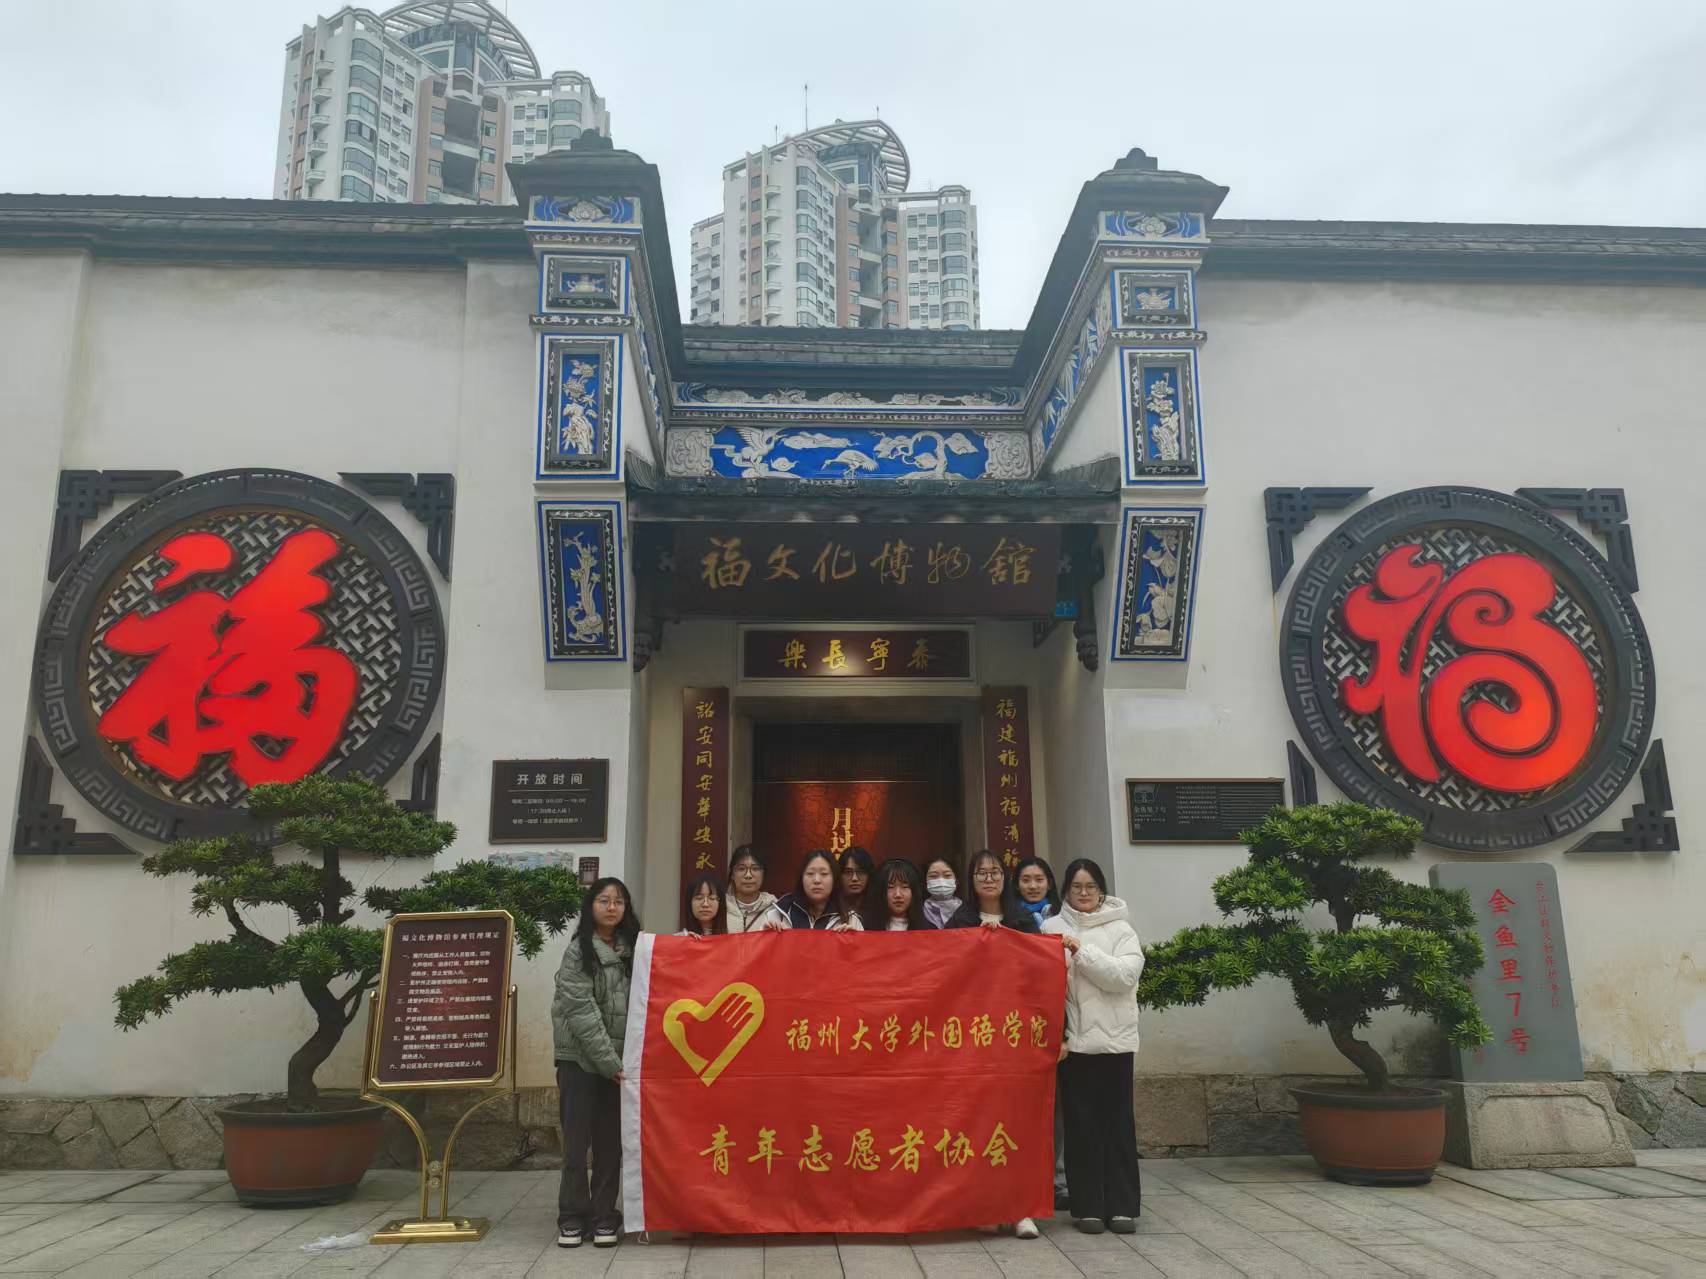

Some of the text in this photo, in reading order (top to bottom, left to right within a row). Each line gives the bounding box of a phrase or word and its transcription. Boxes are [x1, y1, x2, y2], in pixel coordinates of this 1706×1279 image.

[701, 537, 1036, 589] 福文化博物館
[98, 527, 361, 789] 福
[517, 773, 583, 785] 开放时间
[785, 1008, 1050, 1057] 福州大学外国语学院
[699, 1121, 1019, 1176] 青年志愿者协会
